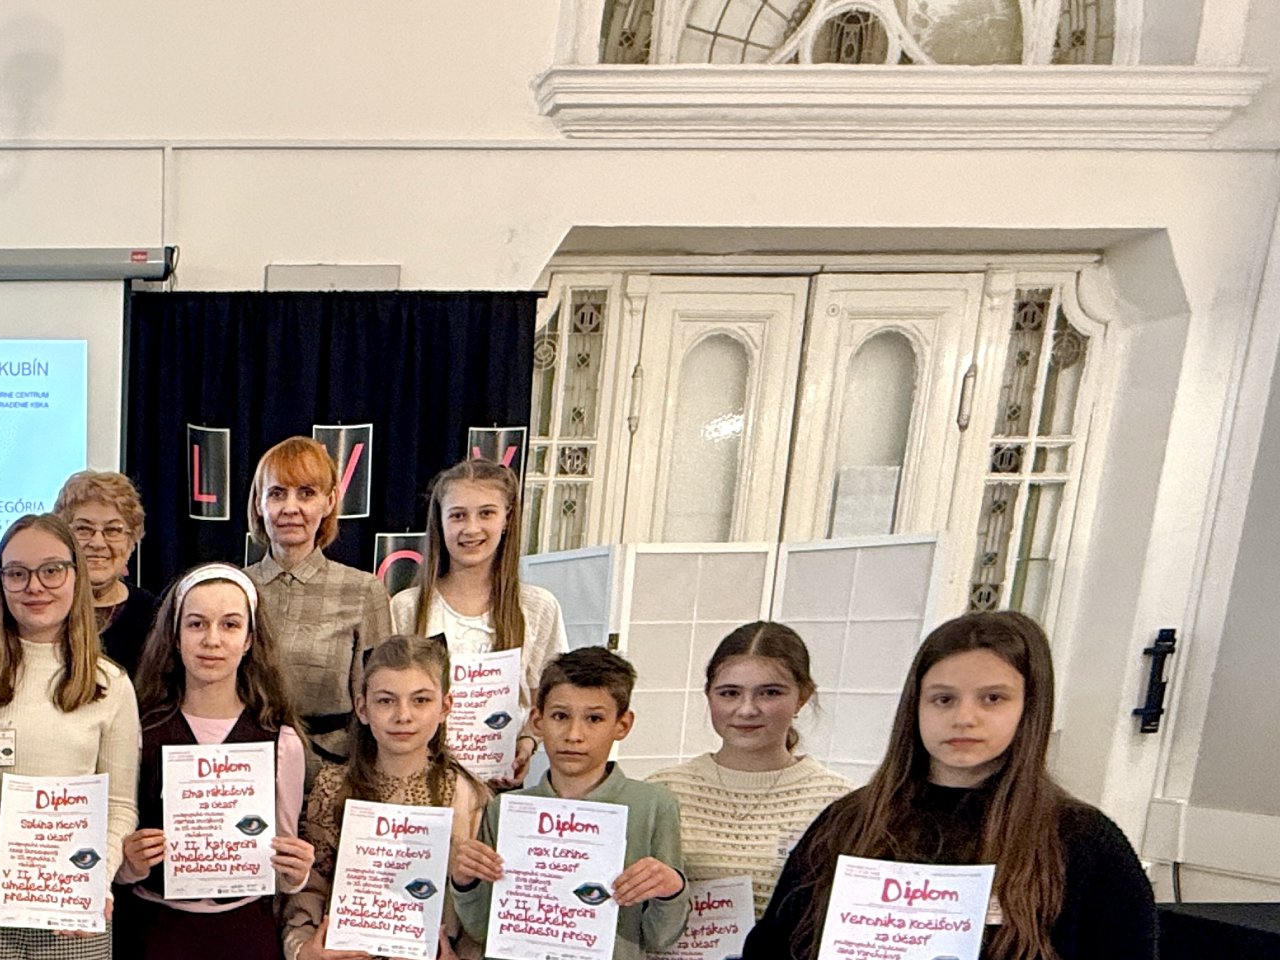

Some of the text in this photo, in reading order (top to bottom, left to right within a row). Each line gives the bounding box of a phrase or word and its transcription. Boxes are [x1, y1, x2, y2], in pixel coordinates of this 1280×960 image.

[194, 444, 216, 503] L
[454, 663, 501, 682] Diplom
[198, 756, 251, 778] Diplom
[36, 788, 88, 811] Diplom
[376, 816, 429, 839] Diplom
[538, 812, 599, 837] Diplom
[171, 851, 241, 862] umeleckého
[174, 862, 260, 876] prednesu prózy
[2, 881, 73, 894] umeleckého
[882, 878, 959, 906] Diplom
[3, 892, 91, 910] prednesu prózy
[538, 899, 595, 919] kategórii
[691, 892, 733, 916] iplom
[337, 907, 406, 922] umeleckého
[498, 909, 576, 929] umeleckého
[840, 912, 971, 932] Veronika Kočišová
[338, 918, 424, 938] prednesu prózy
[499, 922, 598, 947] prednesu prózy
[875, 933, 932, 946] za účasť
